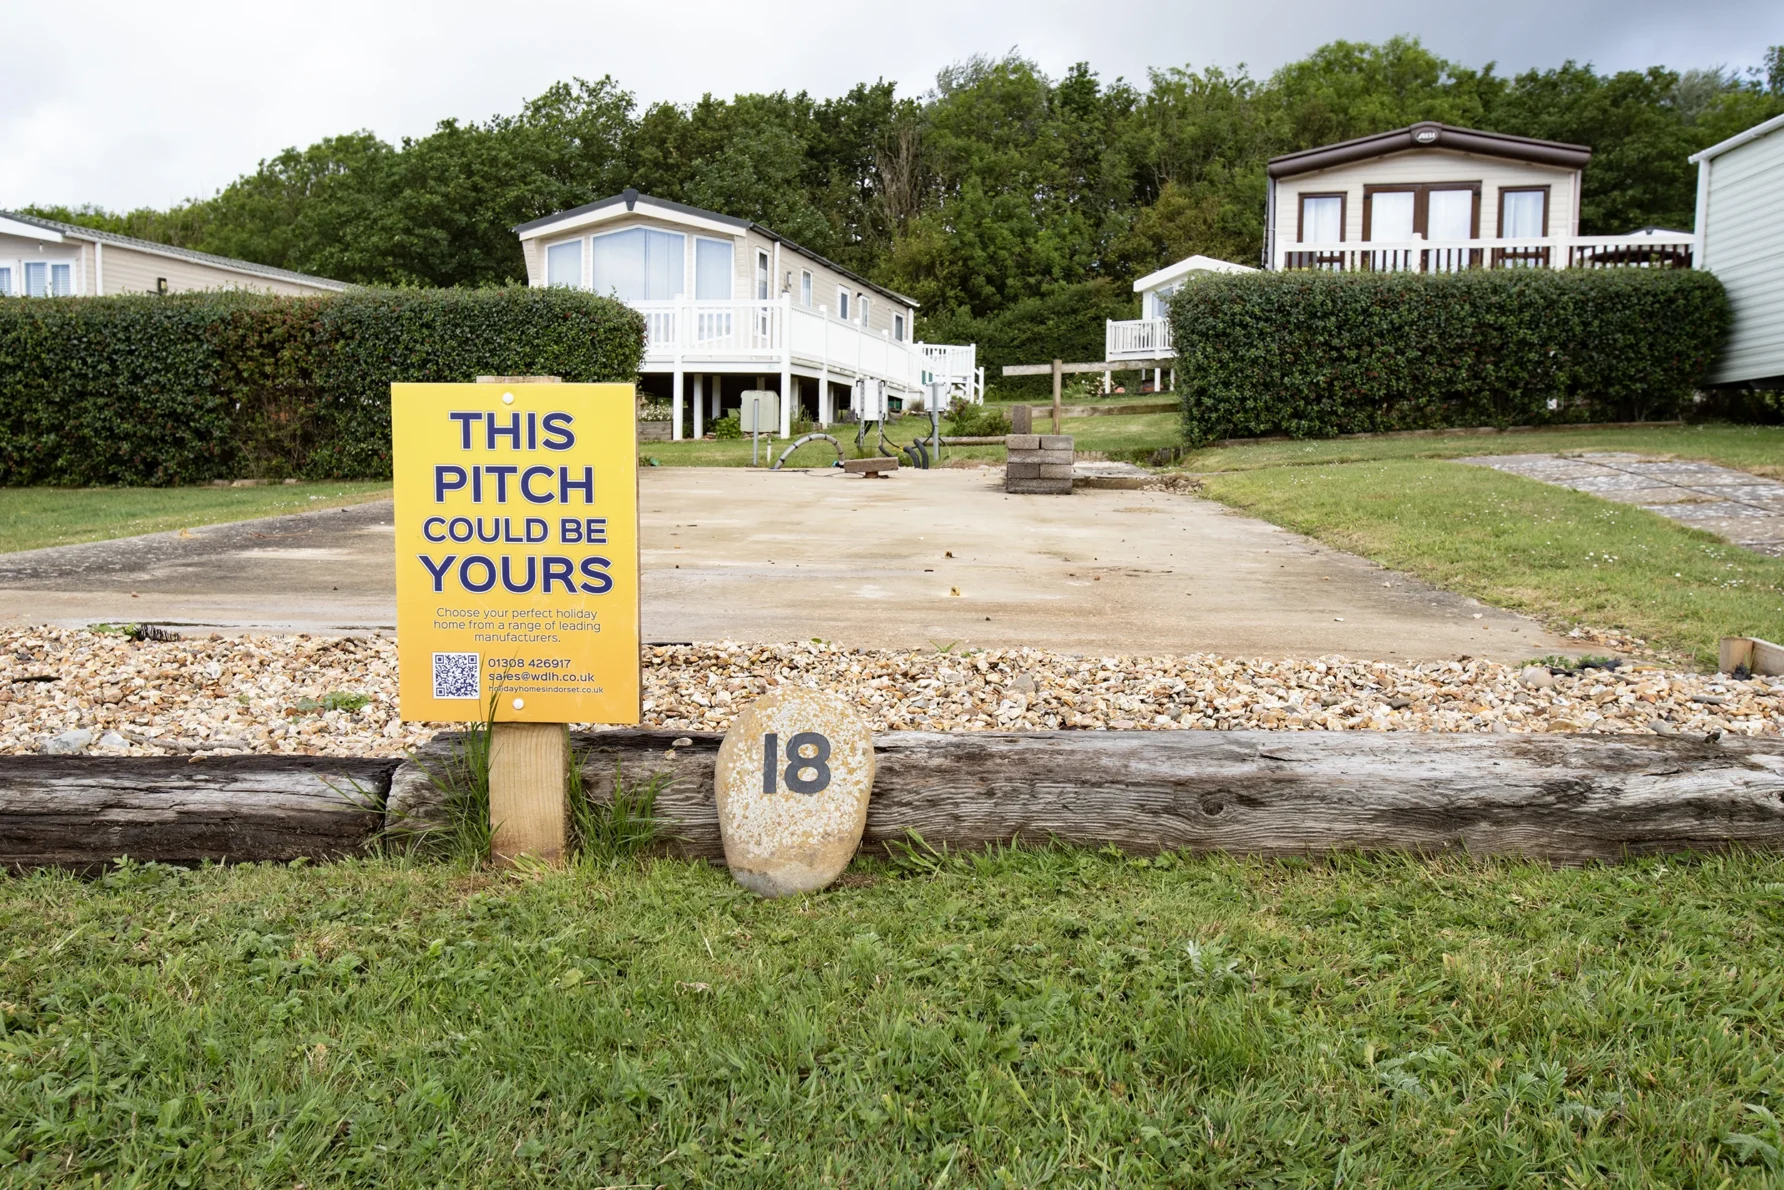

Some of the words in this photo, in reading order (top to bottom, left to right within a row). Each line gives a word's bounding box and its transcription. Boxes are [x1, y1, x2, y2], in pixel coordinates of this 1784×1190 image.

[448, 411, 576, 451] THIS
[433, 465, 595, 505] PITCH
[422, 516, 550, 544] COULD
[559, 518, 608, 544] BE
[417, 554, 614, 595] YOURS
[436, 607, 481, 618] Choose
[483, 609, 508, 620] your
[511, 608, 553, 620] perfect
[556, 608, 598, 621] holiday
[433, 620, 466, 630] home
[468, 620, 495, 630] from
[497, 622, 505, 630] a
[508, 622, 542, 633] range
[544, 620, 556, 630] of
[558, 621, 601, 633] leading
[474, 632, 561, 643] manufacturers.
[488, 658, 525, 668] 01308
[528, 658, 571, 669] 426917
[488, 672, 595, 682] sales@wdlh.co.uk
[762, 732, 831, 795] 18
